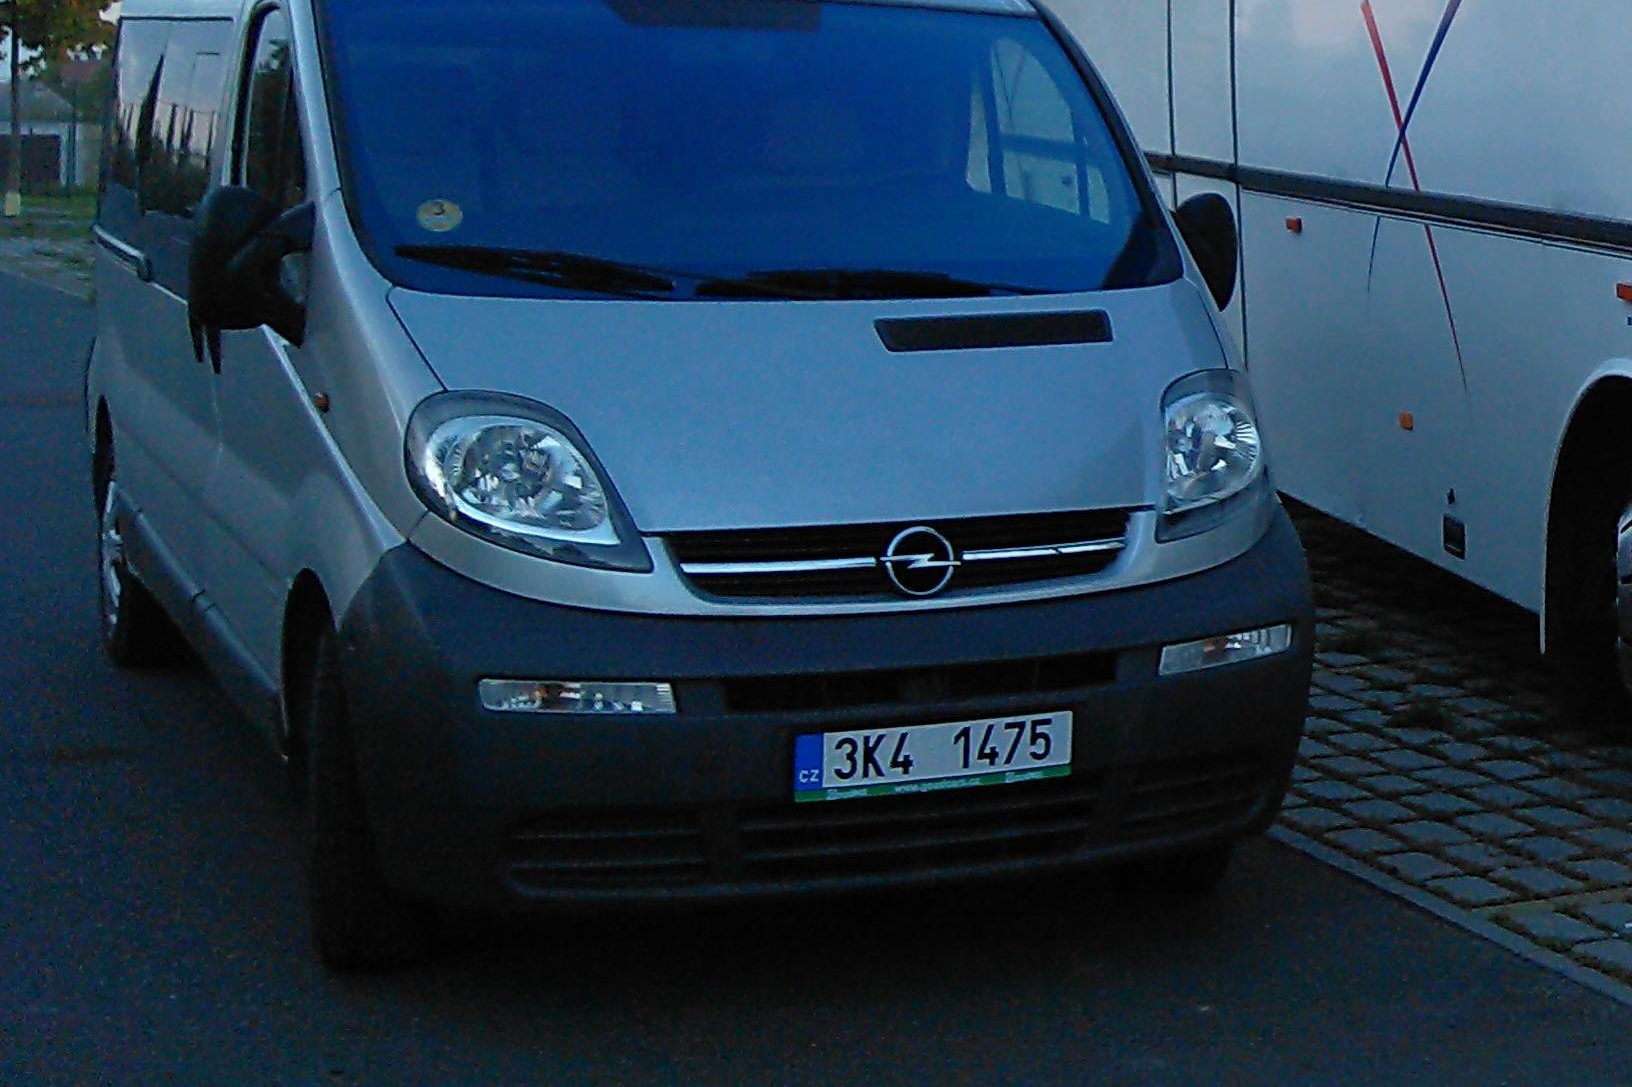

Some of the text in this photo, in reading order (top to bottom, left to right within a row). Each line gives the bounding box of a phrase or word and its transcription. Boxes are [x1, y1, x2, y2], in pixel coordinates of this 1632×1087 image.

[833, 717, 1053, 780] 3K4 1475
[799, 767, 819, 784] CZ
